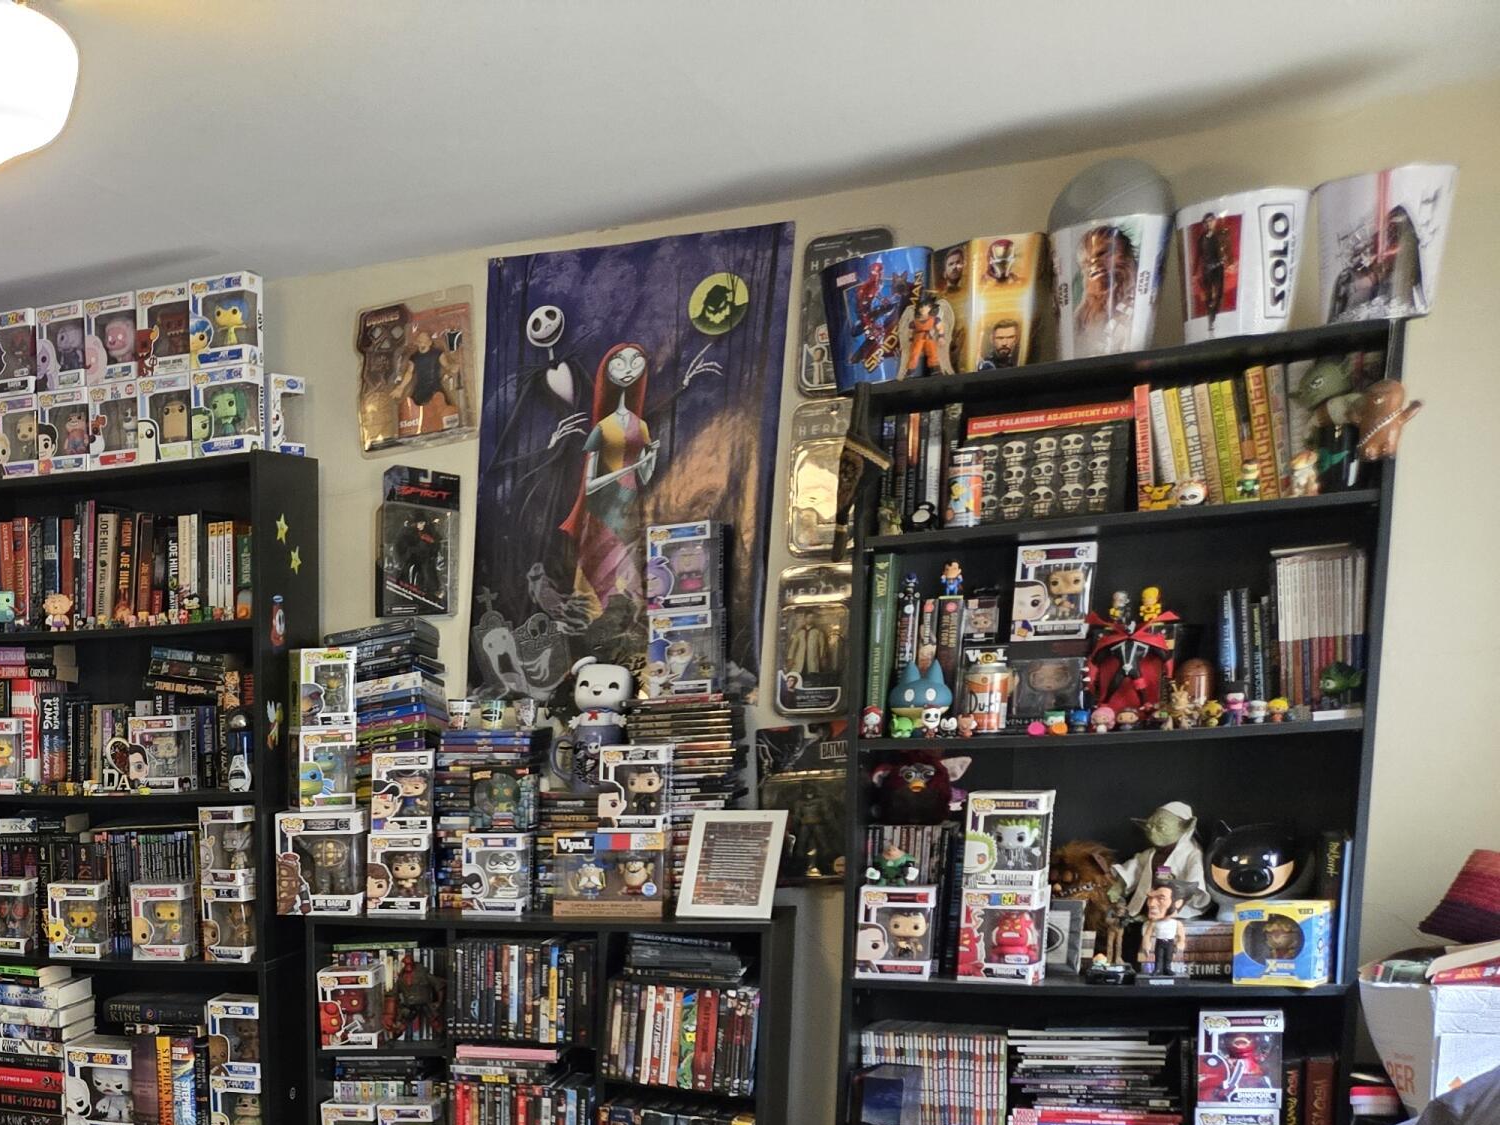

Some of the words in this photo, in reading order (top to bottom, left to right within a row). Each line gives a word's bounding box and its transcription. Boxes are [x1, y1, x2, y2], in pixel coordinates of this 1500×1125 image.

[1268, 212, 1290, 308] SOLO
[972, 419, 998, 430] CHUCK
[1047, 409, 1101, 422] ADJUSTMENT
[100, 518, 108, 535] JOE
[100, 538, 108, 557] HILL
[168, 540, 178, 559] JOE
[120, 552, 130, 569] JOE
[168, 559, 178, 577] HILL
[119, 571, 130, 589] HILL
[43, 699, 52, 730] KING
[821, 742, 847, 758] BATMA
[339, 820, 349, 829] 65
[110, 1012, 141, 1022] KING
[2, 1045, 19, 1053] KING
[161, 1049, 169, 1099] STEPHEN
